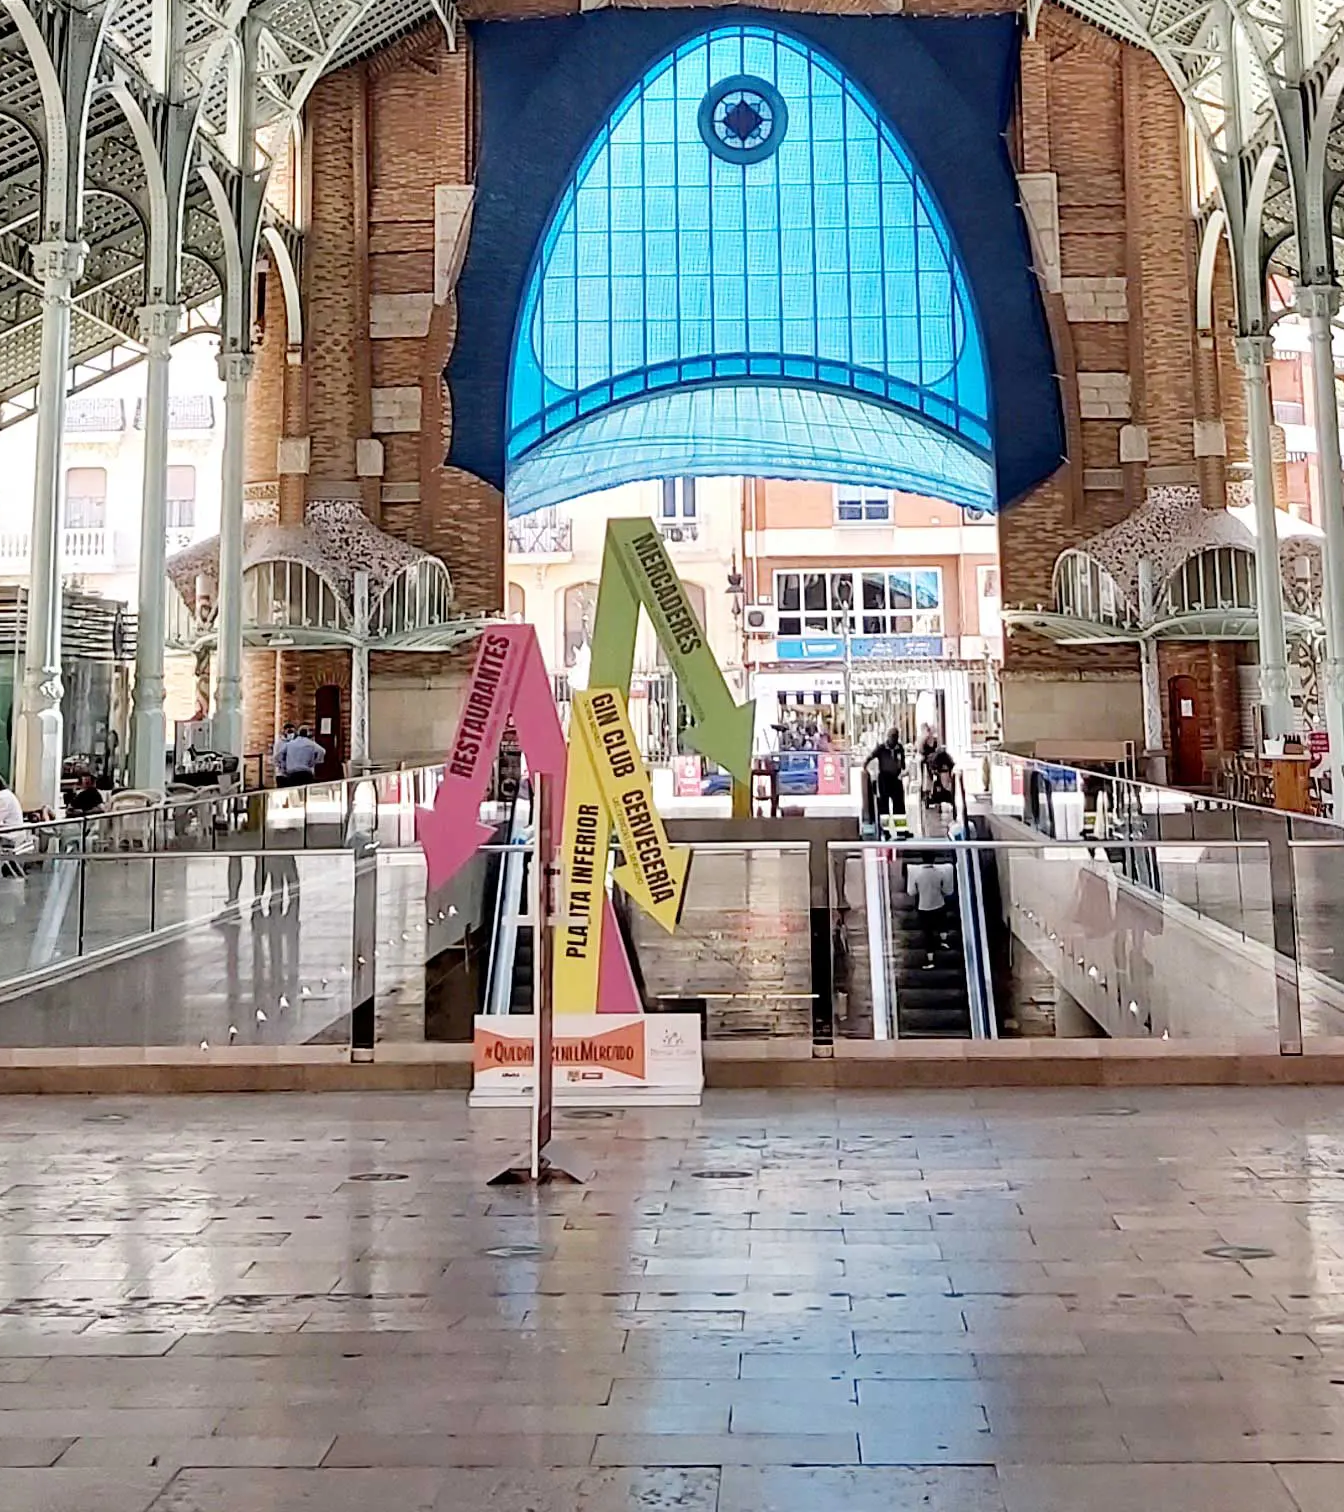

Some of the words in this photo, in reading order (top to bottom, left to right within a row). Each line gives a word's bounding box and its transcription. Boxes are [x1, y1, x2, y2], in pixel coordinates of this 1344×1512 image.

[632, 531, 702, 655] MERCADERES
[450, 634, 510, 778] RESTAURANTES
[591, 692, 621, 727] GIN
[602, 729, 635, 778] CLUB
[571, 804, 599, 885] INFERIOR
[621, 789, 677, 905] CERVECERÍA
